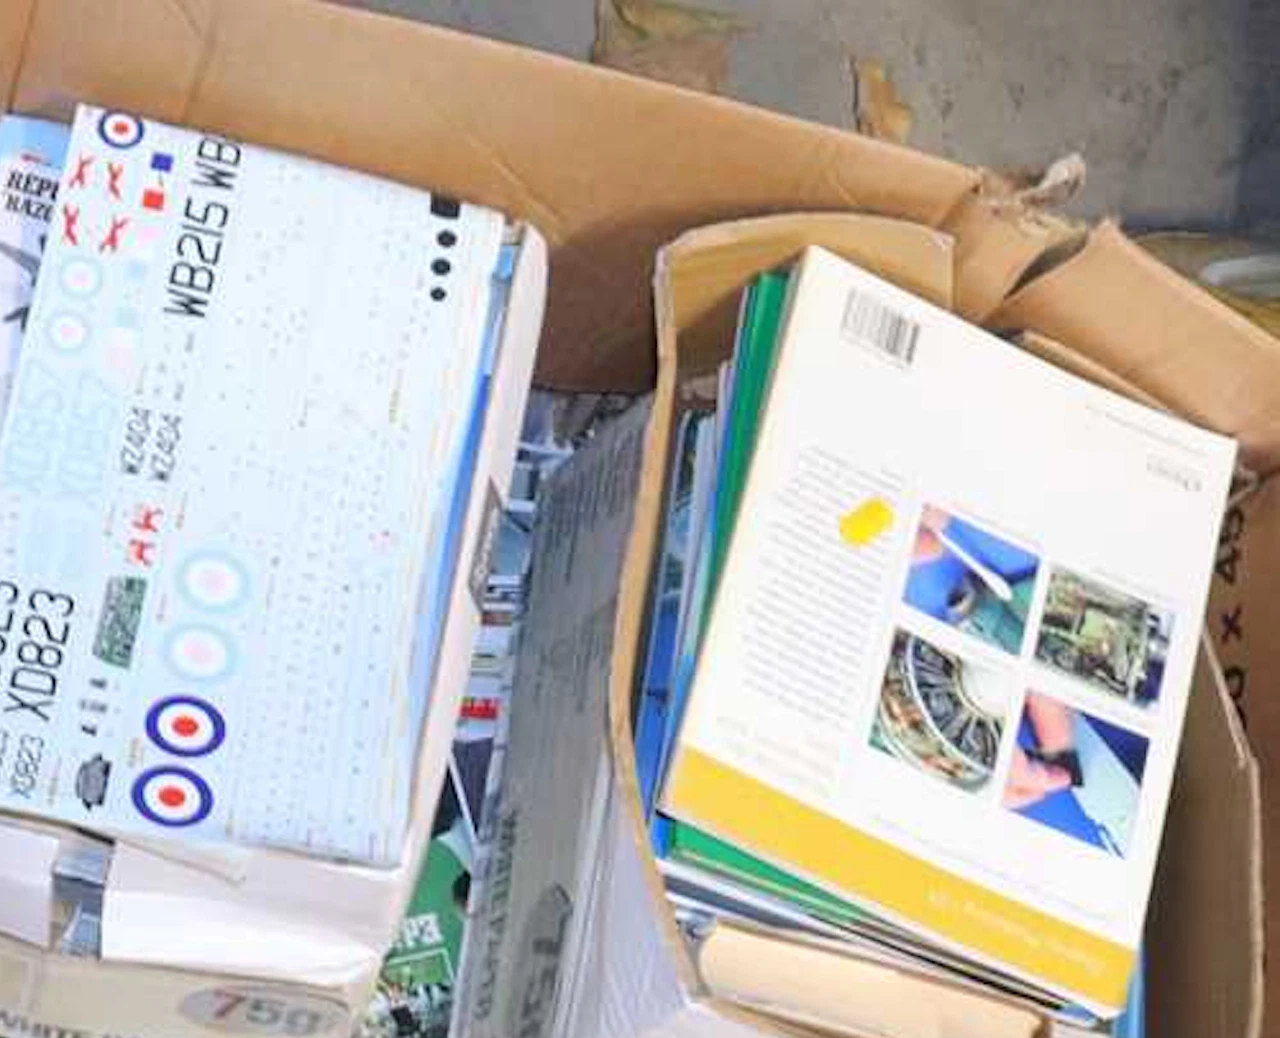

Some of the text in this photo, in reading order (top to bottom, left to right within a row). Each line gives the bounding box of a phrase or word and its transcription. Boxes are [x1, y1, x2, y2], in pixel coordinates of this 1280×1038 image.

[165, 198, 231, 319] WB215
[3, 587, 77, 724] XD823
[207, 987, 329, 1038] 75g
